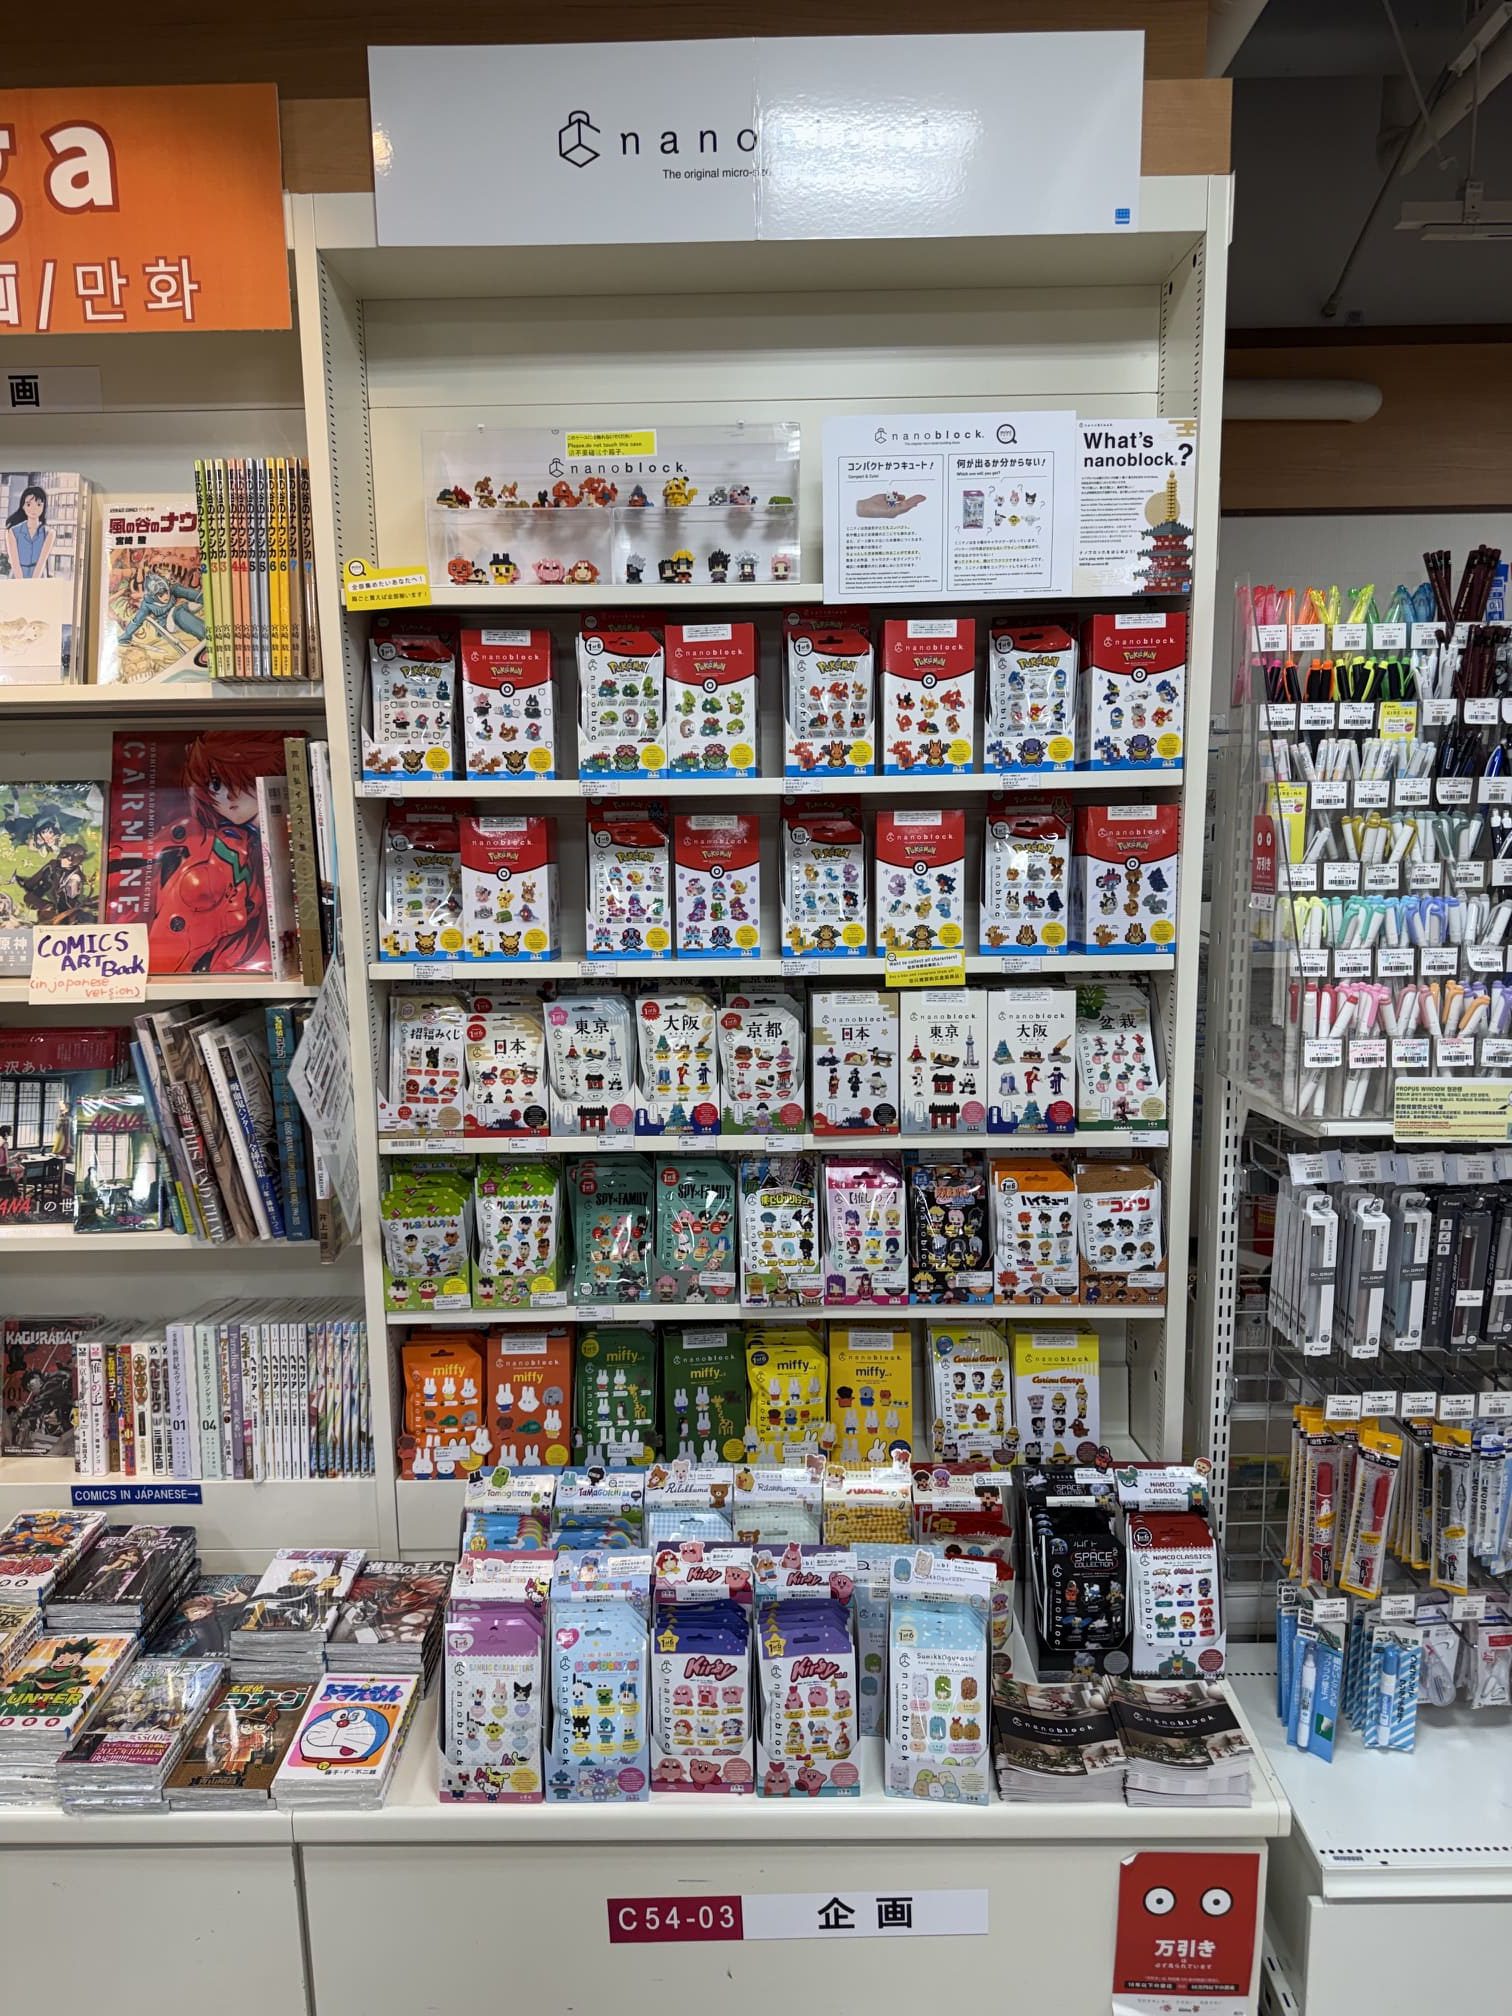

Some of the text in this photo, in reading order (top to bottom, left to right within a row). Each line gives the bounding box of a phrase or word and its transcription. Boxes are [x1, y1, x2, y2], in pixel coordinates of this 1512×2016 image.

[663, 168, 719, 181] The original
[8, 375, 40, 407] 画
[1083, 432, 1154, 449] What's
[119, 741, 146, 914] CARMINE
[37, 931, 129, 958] COMICS
[61, 954, 146, 977] ART Book
[48, 977, 110, 993] japanese
[85, 986, 140, 998] version)
[575, 1018, 609, 1035] 東京
[664, 1014, 700, 1031] 大阪
[1100, 1013, 1137, 1029] 盆栽
[746, 1021, 783, 1039] 京都
[842, 1027, 870, 1041] 日本
[930, 1024, 959, 1039] 東京
[1016, 1023, 1049, 1038] 大阪
[494, 1038, 527, 1054] 日本
[606, 1350, 638, 1363] miffy
[433, 1364, 466, 1378] miffy
[690, 1367, 720, 1379] miffy
[777, 1359, 809, 1373] miffy
[855, 1366, 886, 1379] miffy
[513, 1371, 543, 1384] miffy
[1032, 1376, 1084, 1385] Curious George
[173, 1420, 186, 1431] 01
[202, 1420, 217, 1430] 04
[75, 1489, 188, 1501] COMICS IN JAPANESE
[665, 1483, 709, 1494] Rilakkuma
[1074, 1552, 1113, 1562] SPACE
[365, 1561, 449, 1574] 進撃の巨人
[687, 1567, 722, 1582] Kirby
[788, 1571, 823, 1586] Kirby
[684, 1657, 737, 1679] Kirby
[790, 1657, 839, 1680] Kirby
[215, 1690, 310, 1711] コナン
[320, 1684, 404, 1702] ドラえもん
[1024, 1721, 1094, 1733] nanoblock
[1145, 1714, 1214, 1726] nanoblock
[618, 1906, 735, 1932] C54-03
[817, 1896, 913, 1930] 企画
[1154, 1939, 1217, 1958] 万引き
